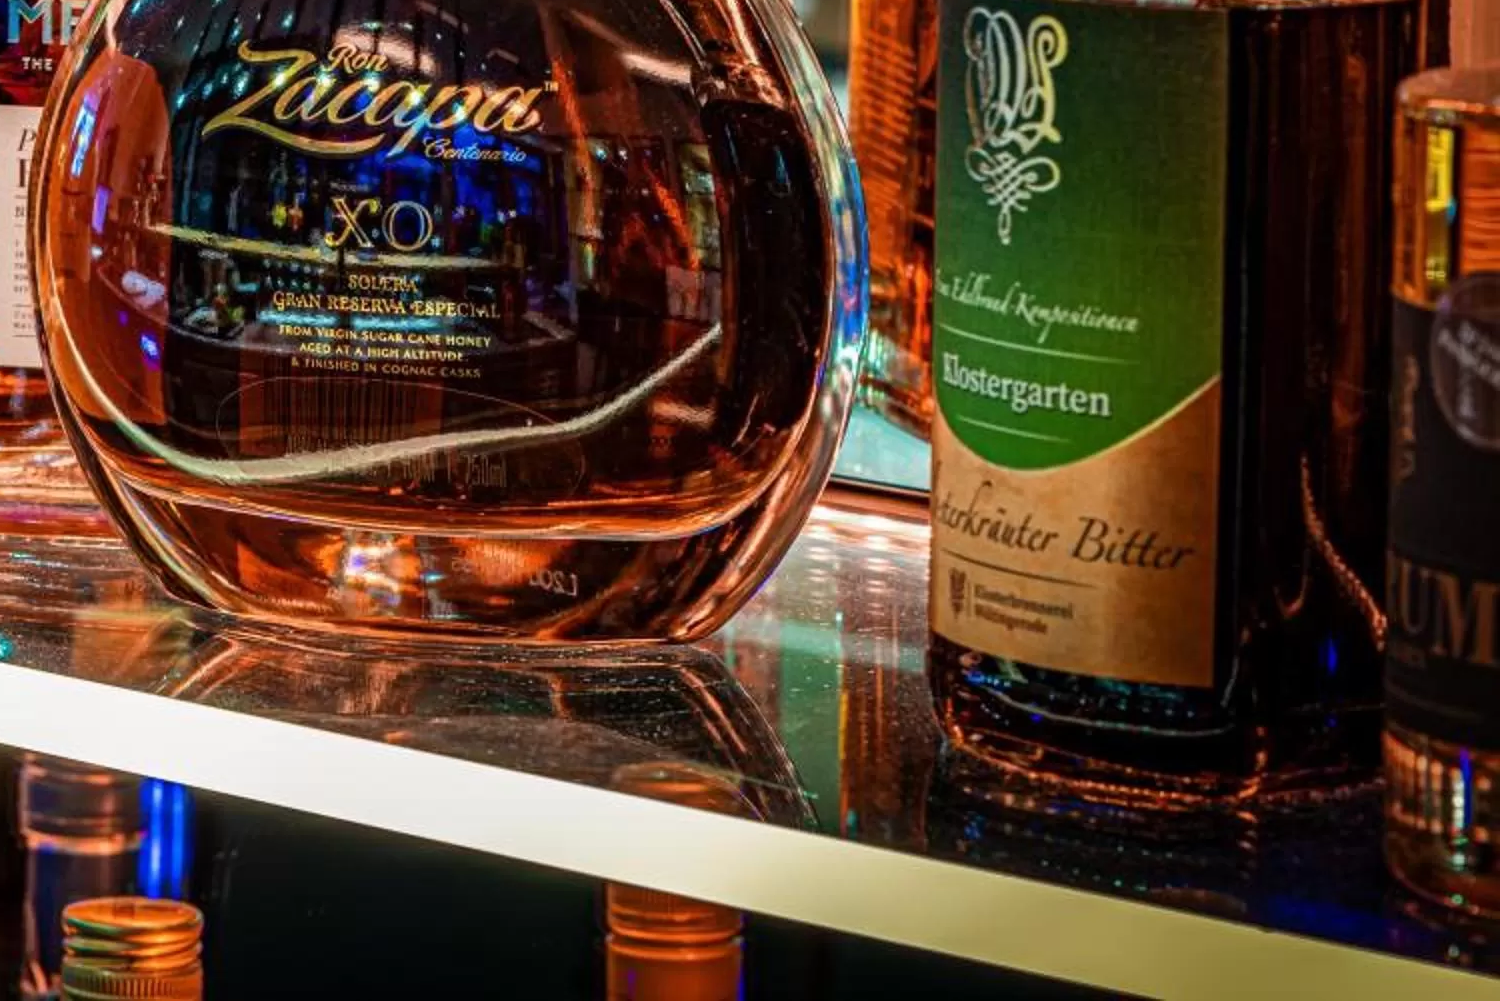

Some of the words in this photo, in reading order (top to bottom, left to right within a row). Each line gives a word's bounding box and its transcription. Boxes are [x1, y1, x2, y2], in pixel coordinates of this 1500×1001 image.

[22, 56, 53, 71] THE
[328, 44, 389, 73] Ron
[202, 39, 542, 158] Zacapa
[423, 136, 527, 163] Centenario
[324, 197, 434, 249] XO
[348, 275, 419, 292] SOLERA
[273, 291, 321, 311] GRAN
[327, 295, 406, 314] RESERVA
[410, 300, 500, 318] ESPECIAL
[278, 325, 312, 337] FROM
[316, 327, 357, 340] VIRGIN
[361, 331, 402, 344] SUGAR
[407, 334, 441, 346] CANE
[444, 335, 492, 348] HONEY
[299, 342, 331, 353] AGED
[335, 345, 350, 356] AT
[355, 347, 363, 357] A
[367, 347, 399, 359] HIGH
[403, 349, 463, 362] ALTITUDE
[305, 358, 359, 372] FINISHED
[363, 363, 377, 374] IN
[382, 363, 434, 377] COGNAC
[439, 367, 481, 379] CASKS
[943, 352, 1111, 415] Klostergarten
[1072, 516, 1194, 570] Bitter
